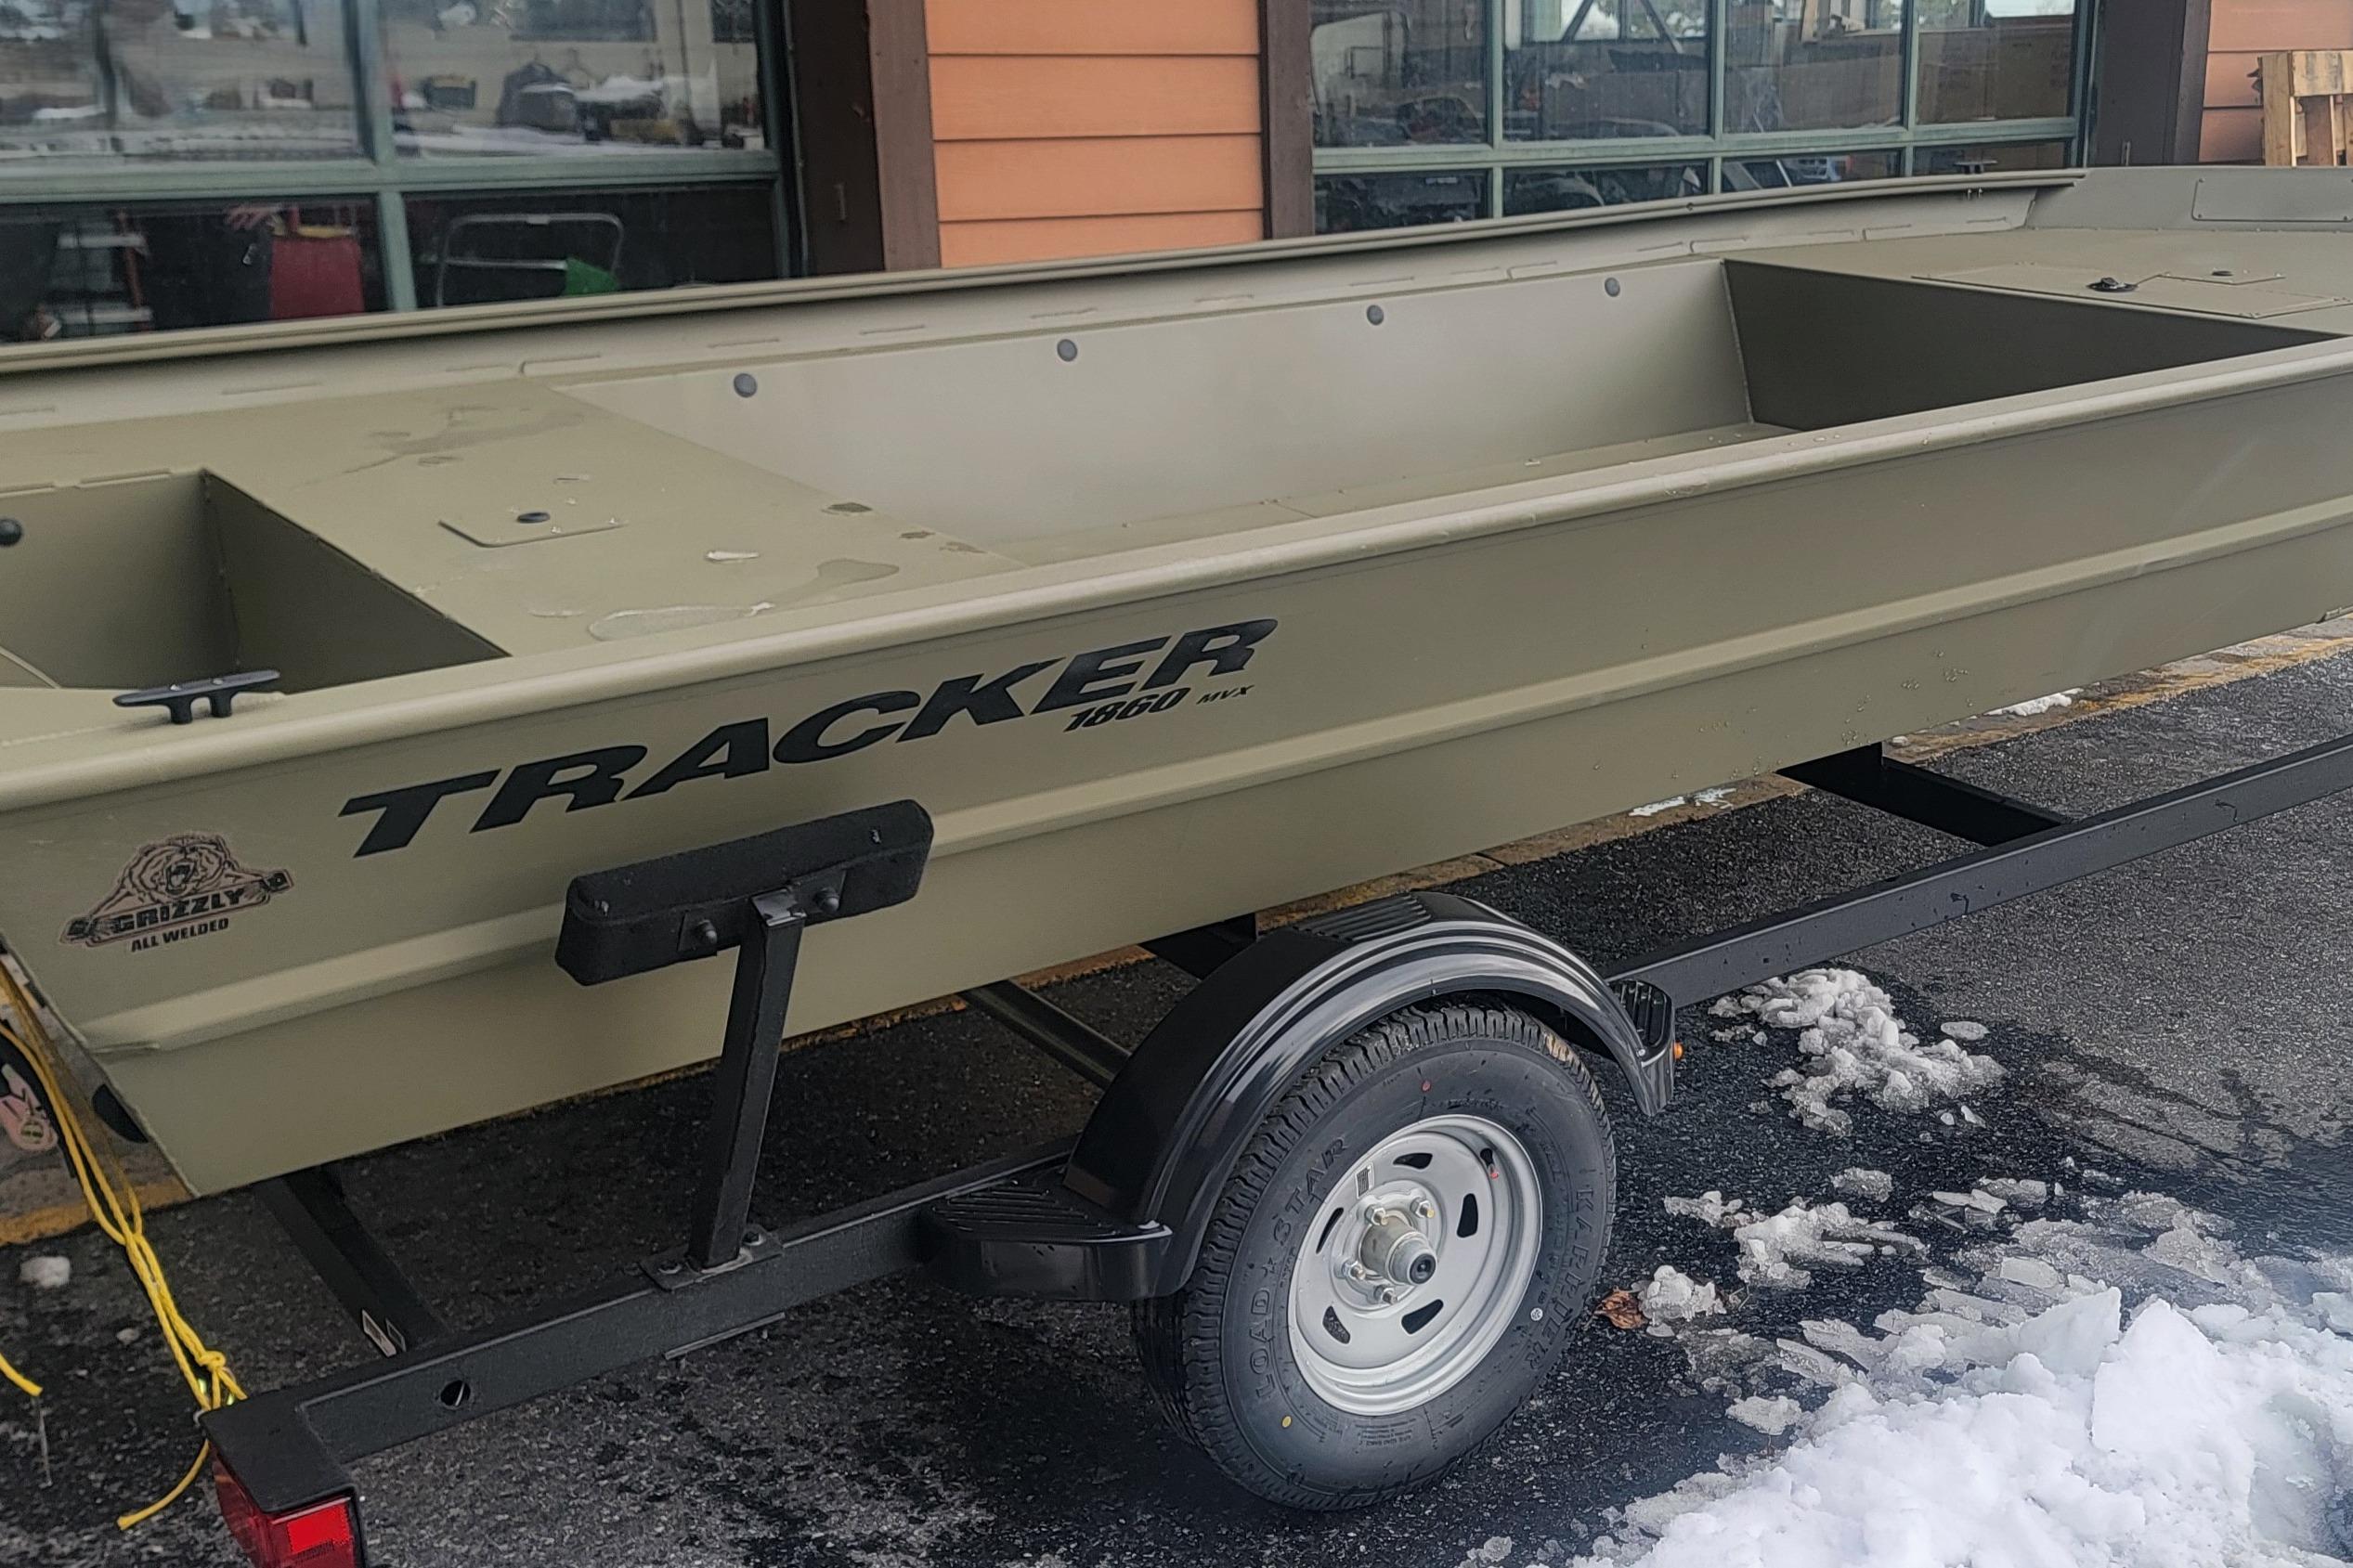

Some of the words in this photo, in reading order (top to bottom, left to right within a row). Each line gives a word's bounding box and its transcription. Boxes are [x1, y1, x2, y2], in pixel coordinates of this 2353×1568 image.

[1063, 688, 1191, 732] 1860
[1196, 684, 1254, 705] MVX
[337, 618, 1278, 858] TRACKER
[110, 887, 244, 934] GRIZZLY
[131, 931, 159, 952] ALL
[162, 917, 229, 944] WELDED
[1249, 1289, 1276, 1400] LOAD
[1272, 1137, 1346, 1247] STAR
